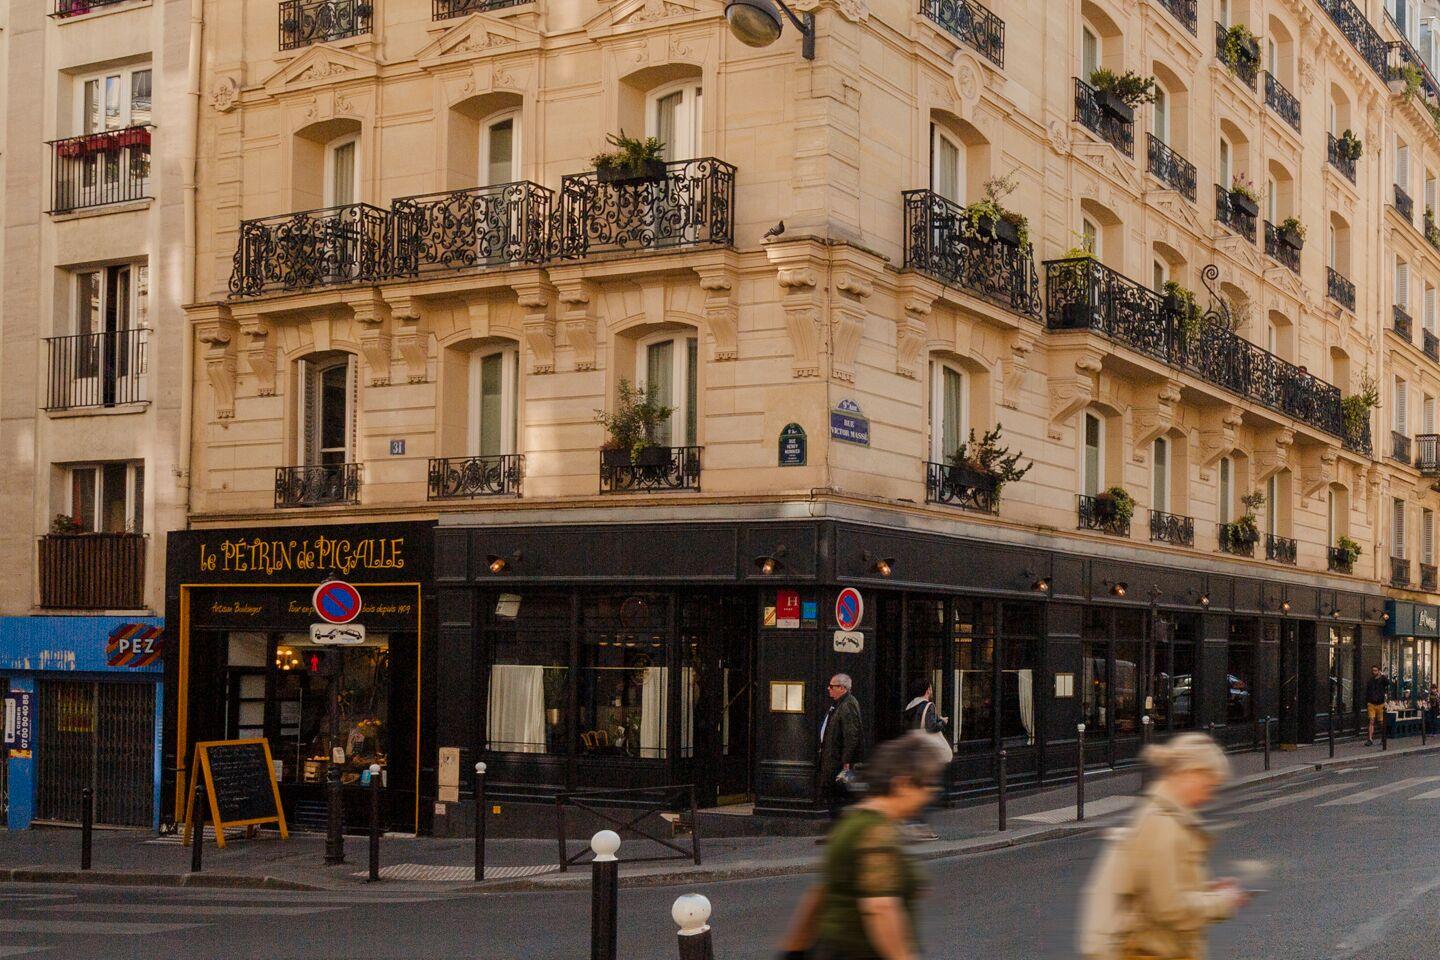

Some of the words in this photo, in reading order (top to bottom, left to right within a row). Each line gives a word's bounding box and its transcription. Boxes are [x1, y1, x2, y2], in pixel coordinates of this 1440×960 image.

[843, 419, 855, 428] RUE
[831, 426, 850, 437] VICTOR
[392, 441, 402, 453] 31
[200, 543, 216, 571] le
[220, 537, 297, 575] PÉTRIN
[296, 540, 315, 570] de
[314, 535, 404, 575] PIGALLE
[787, 596, 798, 607] H
[119, 639, 154, 654] PEZ
